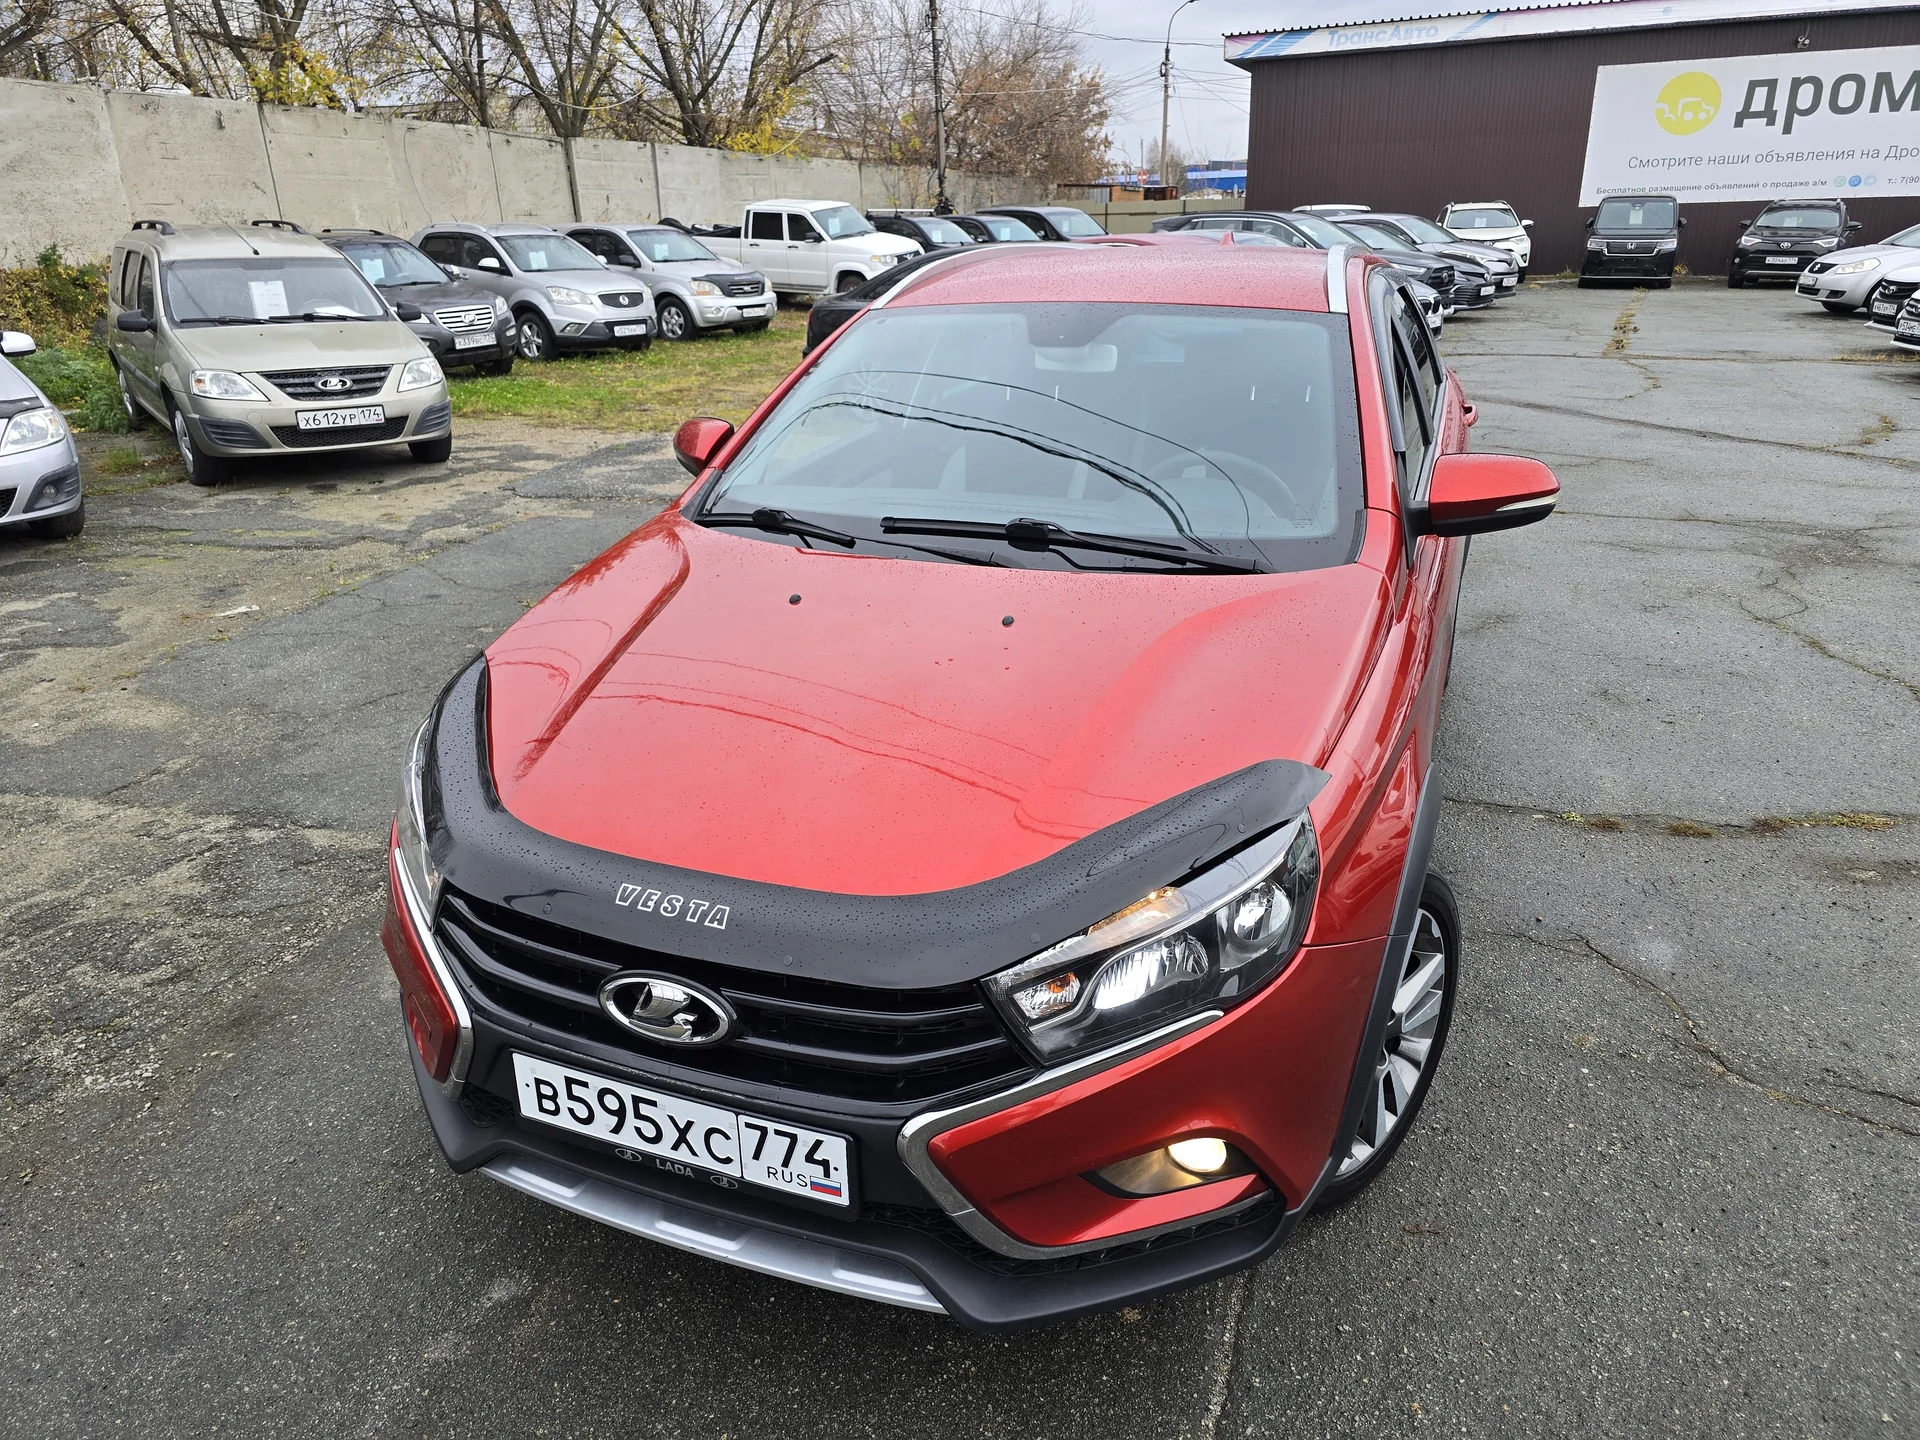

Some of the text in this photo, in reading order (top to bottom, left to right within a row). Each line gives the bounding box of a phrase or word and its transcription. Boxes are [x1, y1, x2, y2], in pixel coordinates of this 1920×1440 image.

[1327, 23, 1439, 47] ТрансАвто
[1733, 70, 1920, 135] дром
[1627, 156, 1703, 170] Смотрите
[1707, 153, 1750, 166] наши
[1754, 149, 1855, 164] объявления
[1860, 149, 1880, 160] на
[1596, 186, 1646, 195] Бесплатное
[1648, 184, 1702, 192] размещение
[1704, 181, 1760, 190] объявлений
[1771, 180, 1809, 189] продаже
[1811, 178, 1827, 188] а/м
[303, 408, 379, 427] Х612УР 174
[615, 883, 731, 929] VESTA
[534, 1073, 832, 1179] В595ХС 774
[655, 1158, 695, 1178] LADA
[767, 1166, 808, 1188] RUS
